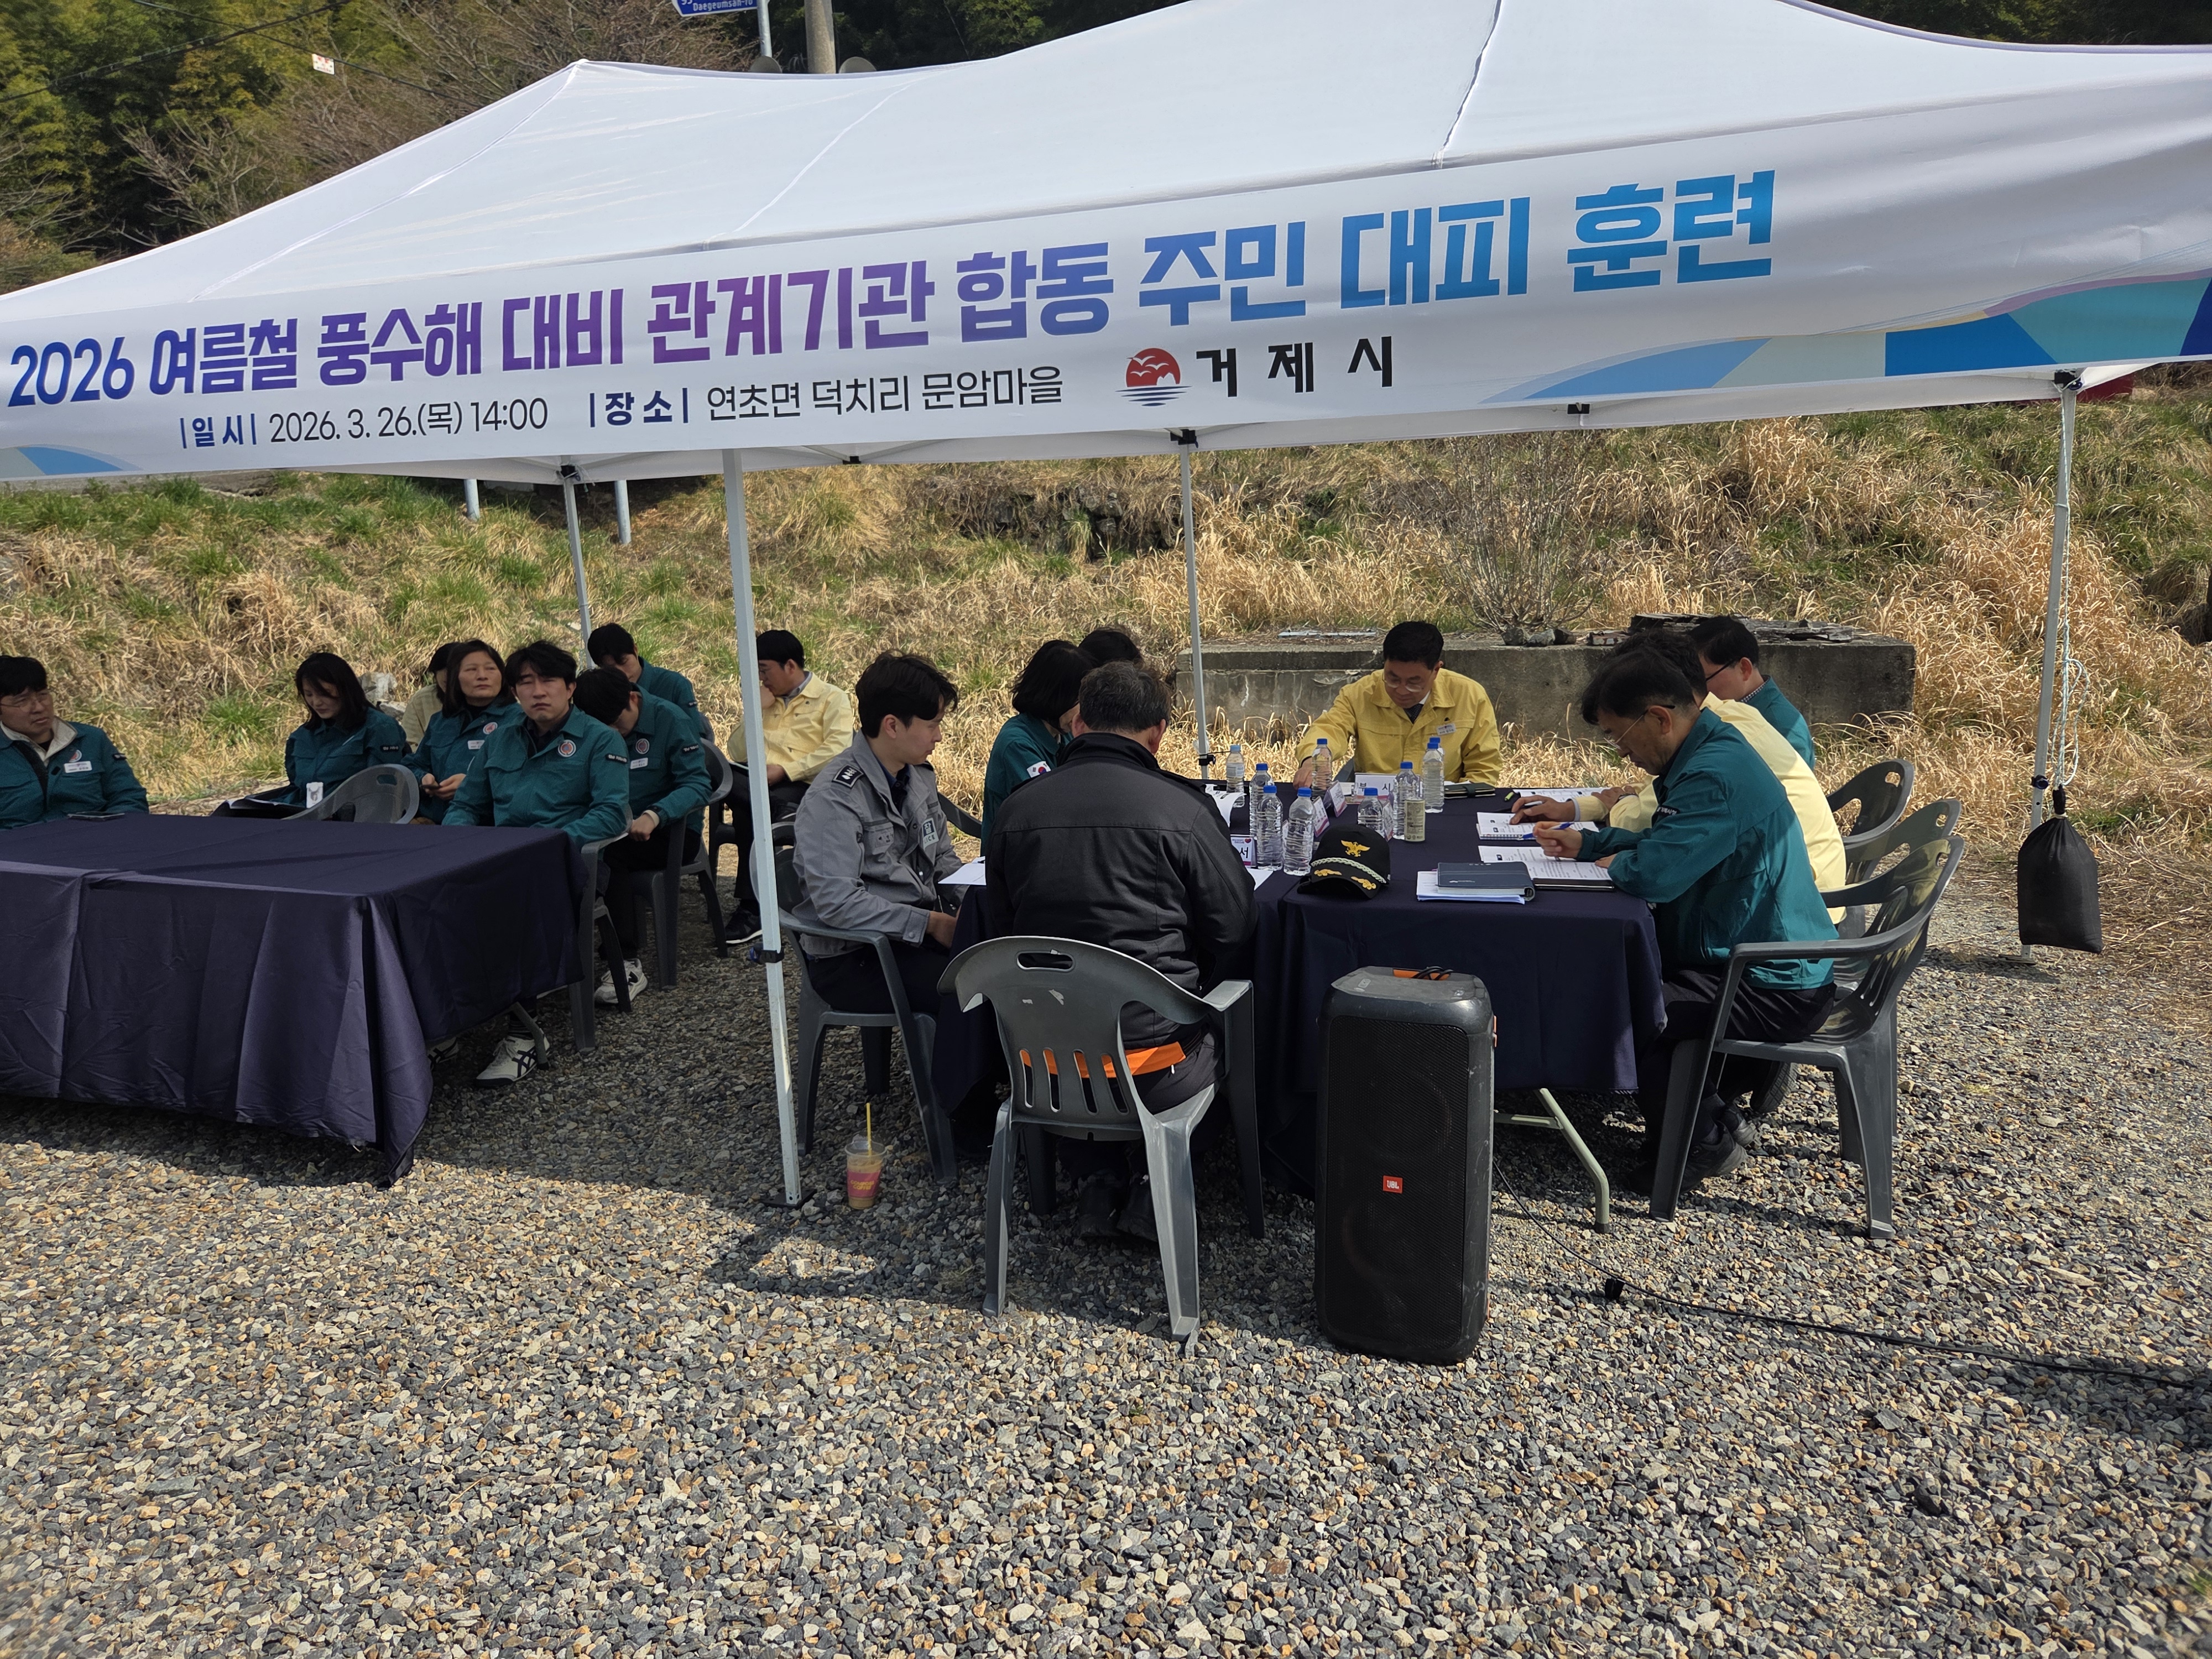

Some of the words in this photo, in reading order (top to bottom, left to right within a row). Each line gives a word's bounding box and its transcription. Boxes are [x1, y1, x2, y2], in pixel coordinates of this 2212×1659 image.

[7, 337, 134, 407] 2026
[149, 319, 298, 395] 여름철
[317, 302, 482, 385] 풍수해
[503, 289, 623, 371] 대비
[648, 260, 935, 364] 관계기관
[957, 242, 1113, 342] 합동
[1139, 221, 1306, 326] 주민
[1341, 197, 1530, 309] 대피
[1567, 170, 1775, 293] 훈련
[471, 398, 547, 431] 14:00
[708, 383, 800, 421] 연초면
[812, 375, 909, 415] 덕치리
[922, 366, 1062, 410] 문암마을
[1386, 1180, 1400, 1189] JBL
